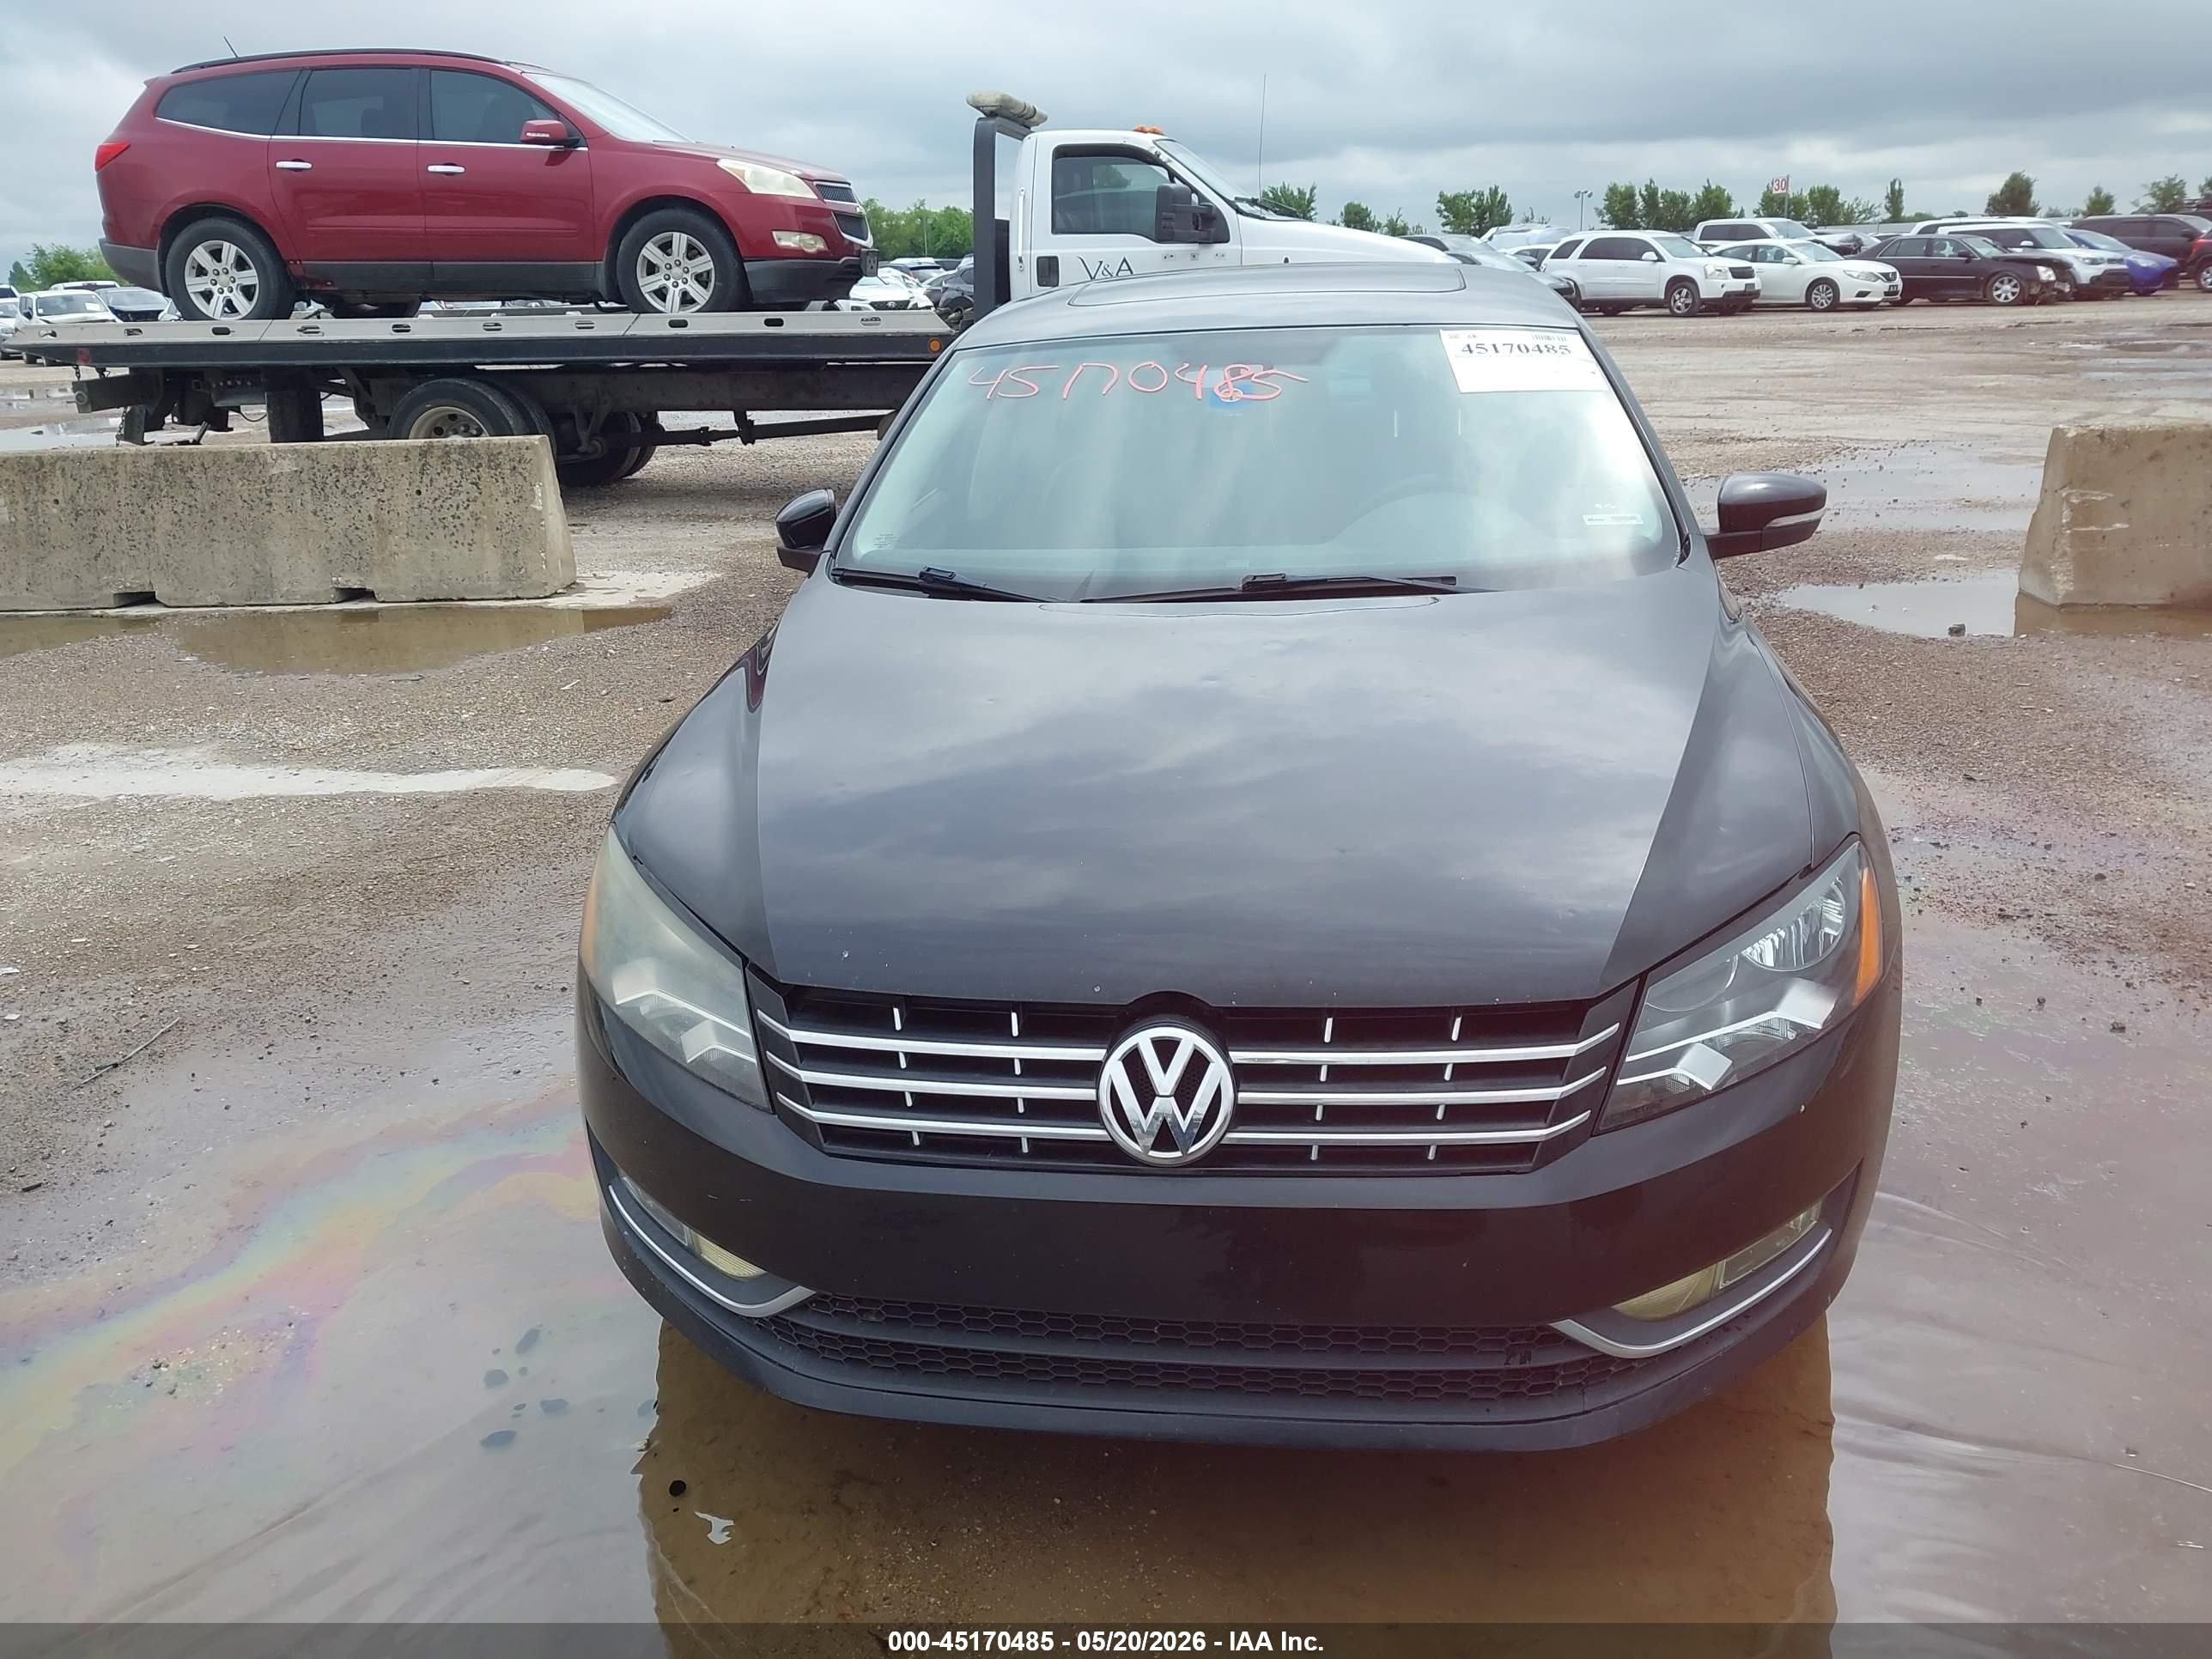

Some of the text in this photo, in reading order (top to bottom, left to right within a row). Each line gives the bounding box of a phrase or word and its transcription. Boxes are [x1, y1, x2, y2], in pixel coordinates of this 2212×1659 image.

[1774, 179, 1786, 191] 30
[1077, 256, 1133, 280] V&A
[1462, 343, 1571, 355] 45170485
